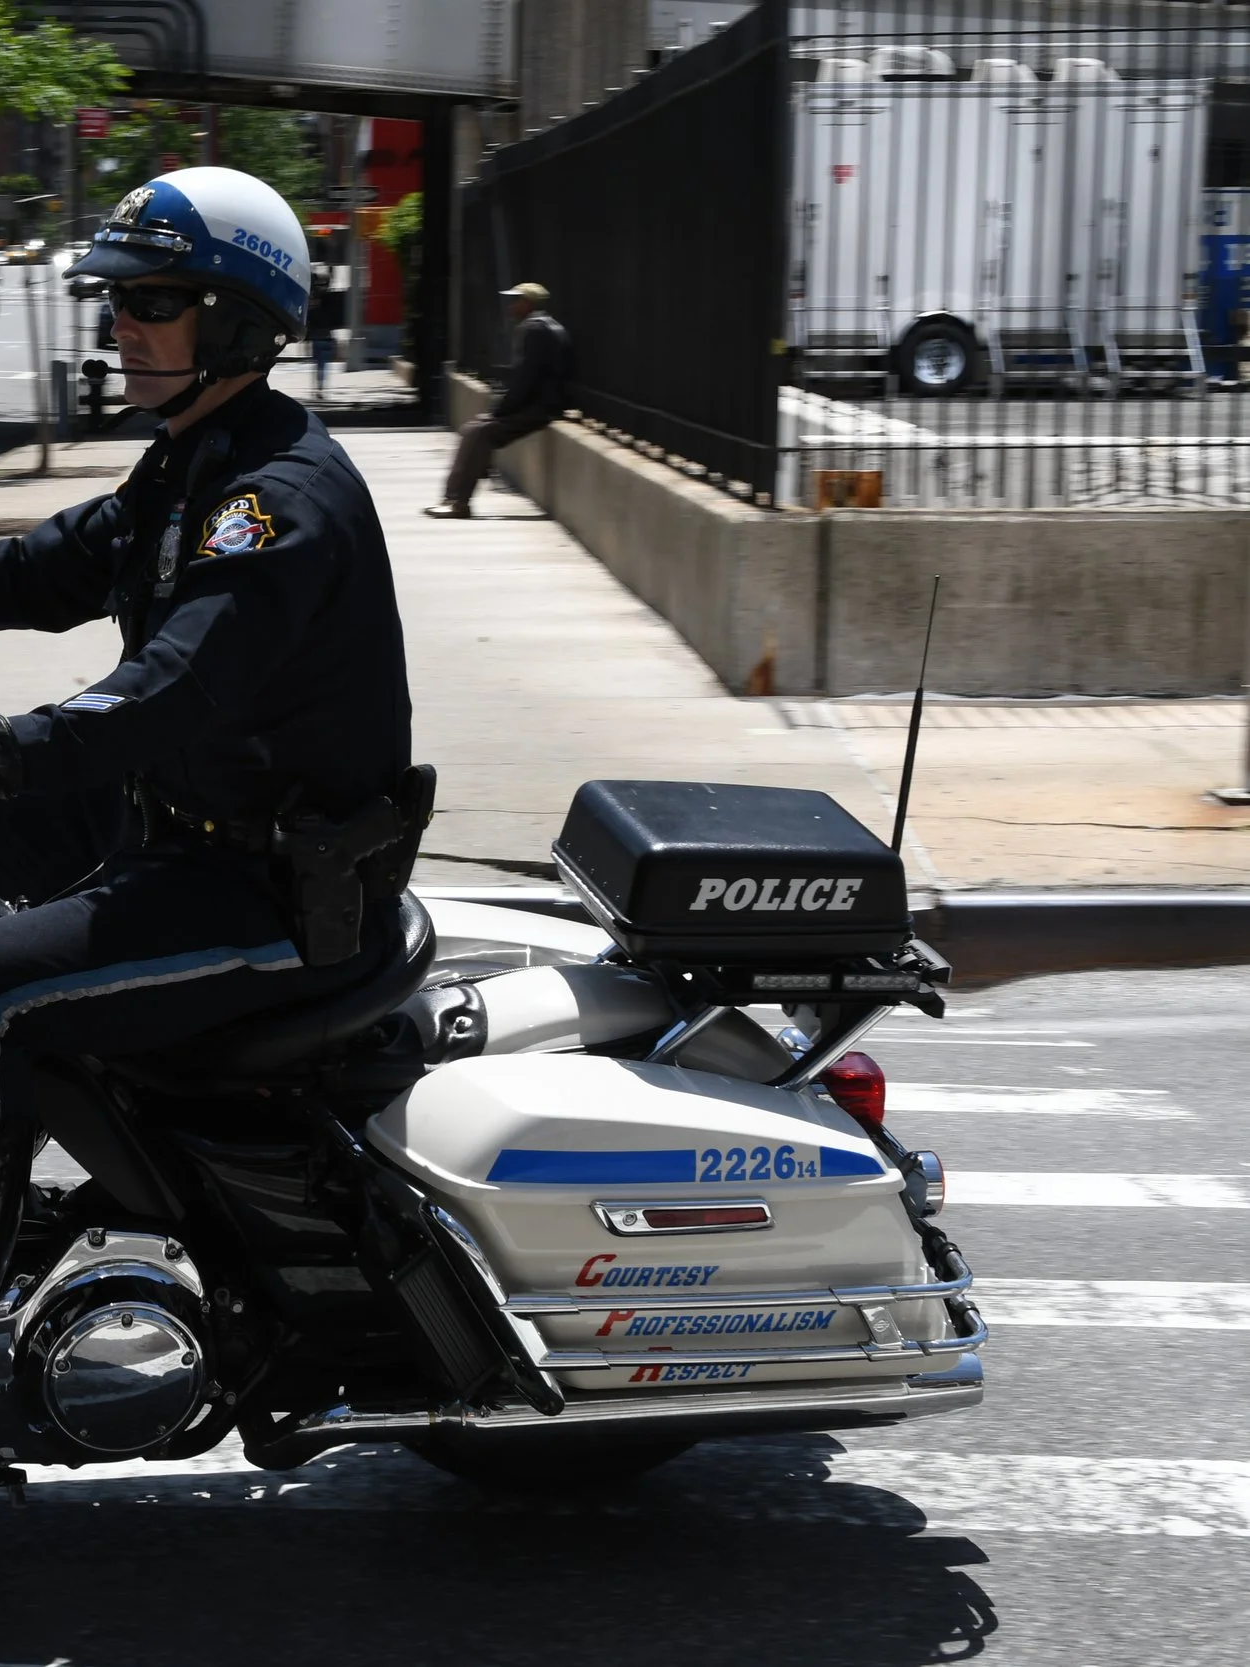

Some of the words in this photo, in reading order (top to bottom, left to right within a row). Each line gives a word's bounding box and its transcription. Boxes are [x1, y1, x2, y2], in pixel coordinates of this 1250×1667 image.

[232, 228, 293, 272] 26047
[688, 877, 864, 912] POLICE
[575, 1253, 720, 1288] COURTESY
